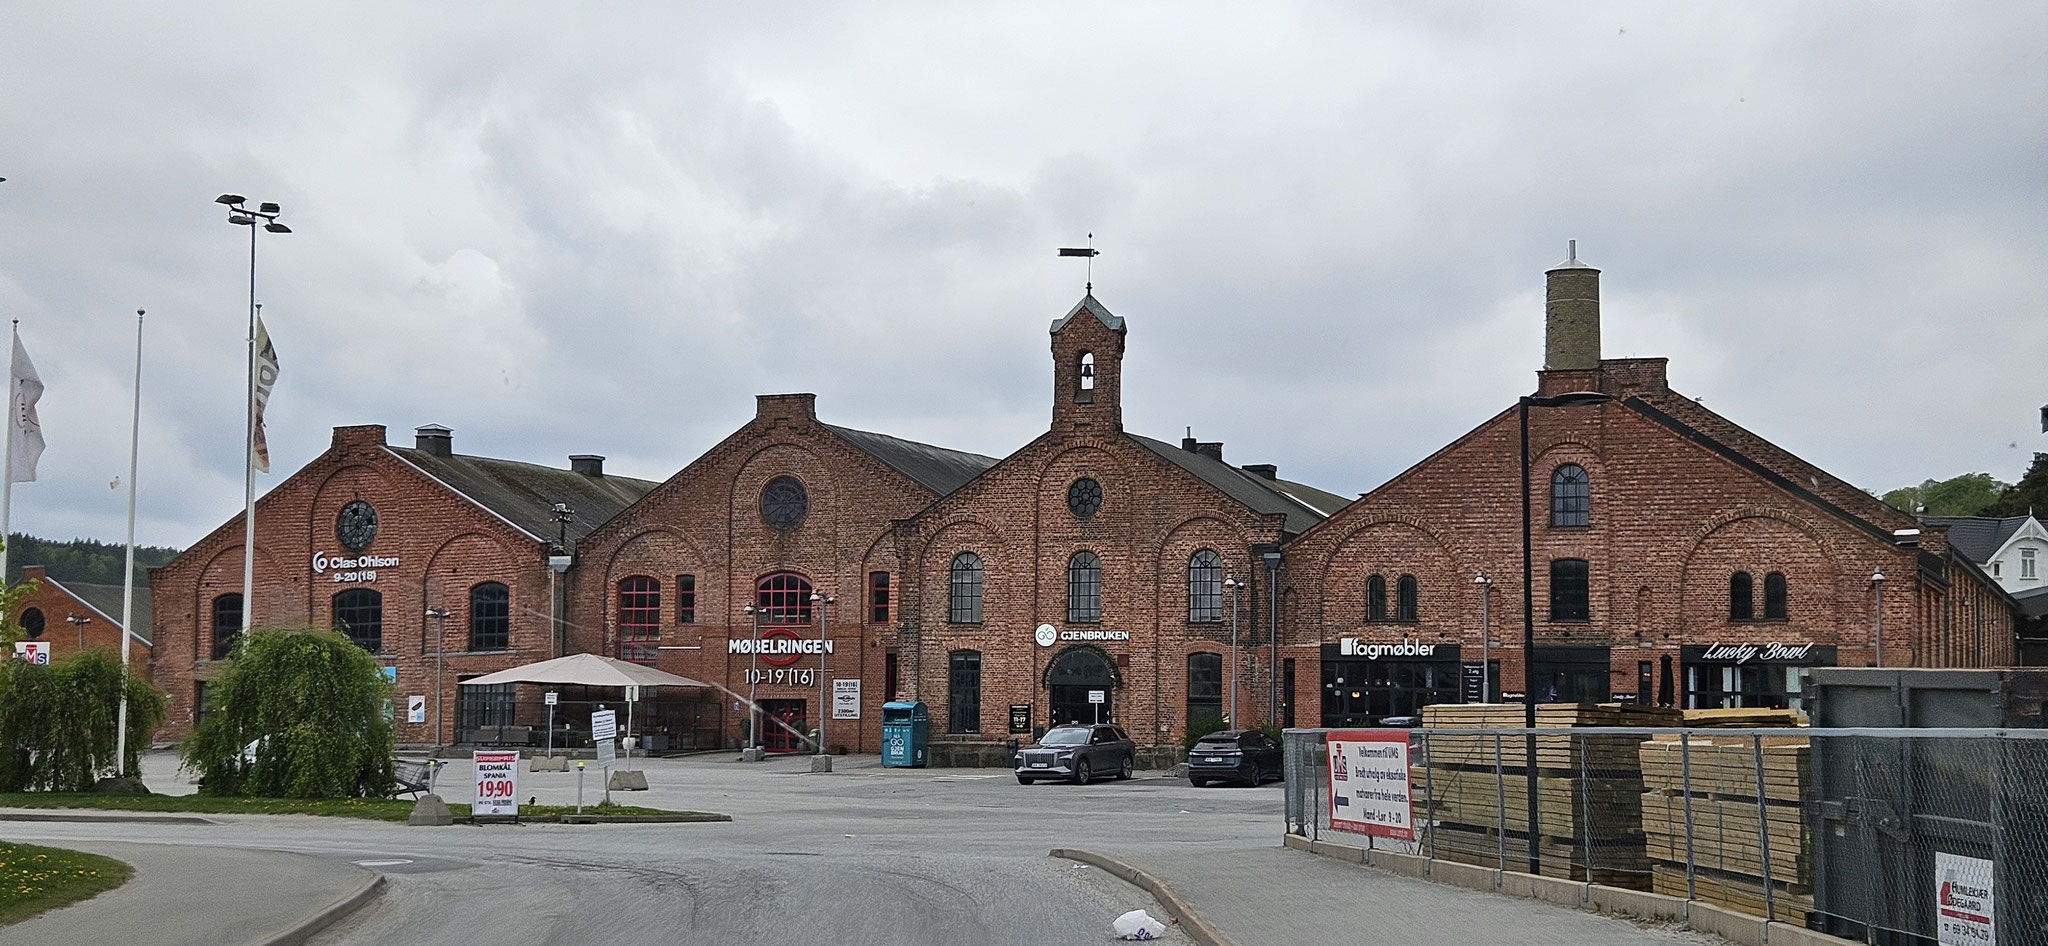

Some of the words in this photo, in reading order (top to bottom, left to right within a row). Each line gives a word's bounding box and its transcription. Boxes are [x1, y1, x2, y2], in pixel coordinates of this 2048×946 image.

[330, 557, 357, 569] Clas
[358, 556, 400, 568] Ohlson
[1060, 631, 1130, 640] GJENBRUKEN
[728, 639, 833, 654] MØBELRINGEN
[1351, 638, 1435, 660] fagmøbler
[1702, 641, 1758, 665] Lucky
[1760, 641, 1814, 660] Bowl
[788, 668, 815, 687] (16)
[1388, 747, 1399, 759] UMS
